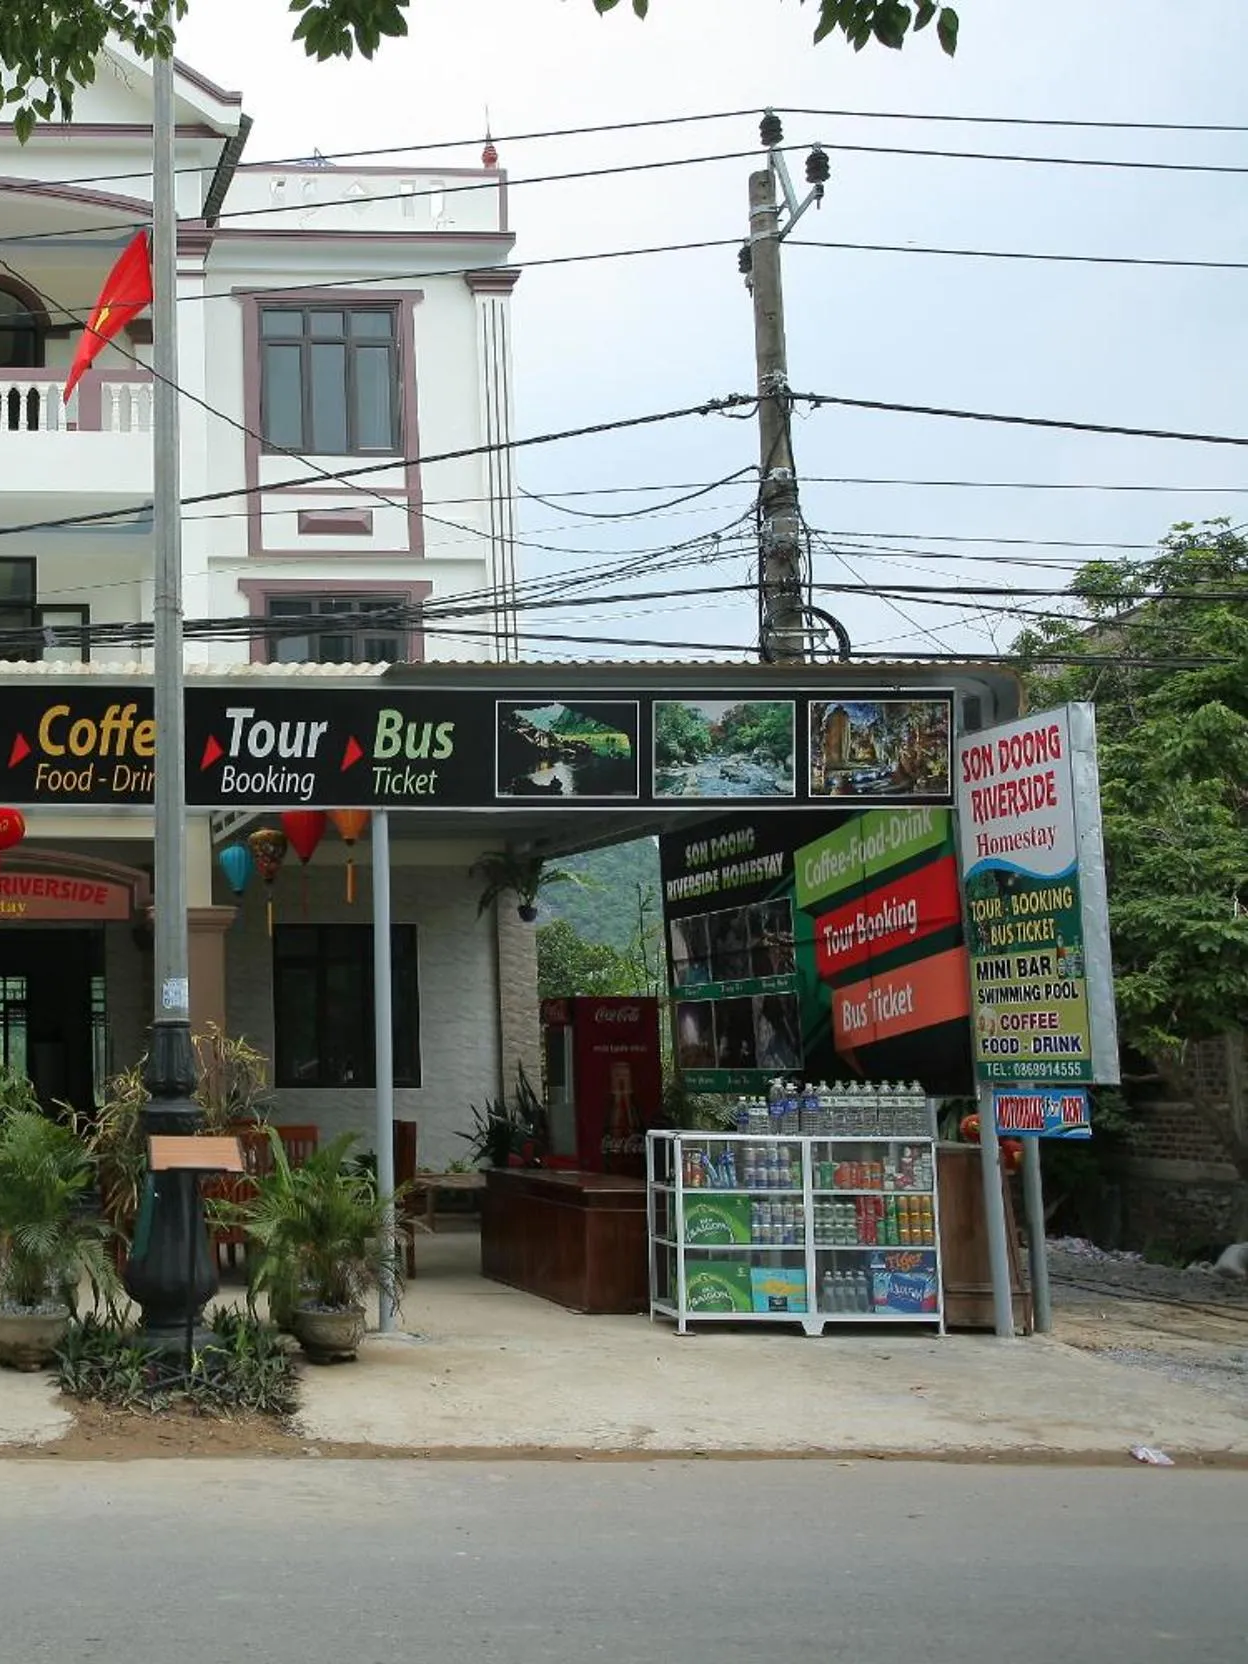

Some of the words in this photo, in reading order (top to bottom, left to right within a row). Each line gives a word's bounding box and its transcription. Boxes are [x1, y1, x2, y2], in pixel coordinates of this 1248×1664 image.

[38, 703, 156, 757] Coffe
[225, 706, 328, 758] Tour
[373, 708, 454, 759] Bus
[961, 743, 994, 783] SON
[998, 724, 1061, 773] DOONG
[35, 762, 92, 792] Food
[112, 764, 156, 792] Drin
[220, 765, 315, 801] Booking
[372, 765, 437, 794] Ticket
[971, 770, 1057, 825] RIVERSIDE
[685, 841, 708, 867] SON
[711, 827, 755, 861] DOONG
[976, 824, 1056, 857] Homestay
[667, 869, 720, 901] RIVERSIDE
[722, 852, 784, 888] HOMESTAY
[970, 898, 1002, 922] TOUR
[1011, 886, 1073, 916] BOOKING
[823, 922, 855, 957] Tour
[856, 899, 918, 943] Booking
[991, 923, 1013, 946] BUS
[1016, 918, 1054, 943] TICKET
[976, 958, 1011, 981] MINI
[1017, 956, 1052, 978] BAR
[842, 998, 868, 1031] Bus
[870, 983, 914, 1021] Ticket
[978, 984, 1041, 1004] SWIMMING
[1045, 981, 1079, 1000] POOL
[1001, 1013, 1059, 1031] COFFEE
[981, 1037, 1020, 1054] FOOD
[1031, 1036, 1082, 1053] DRINK
